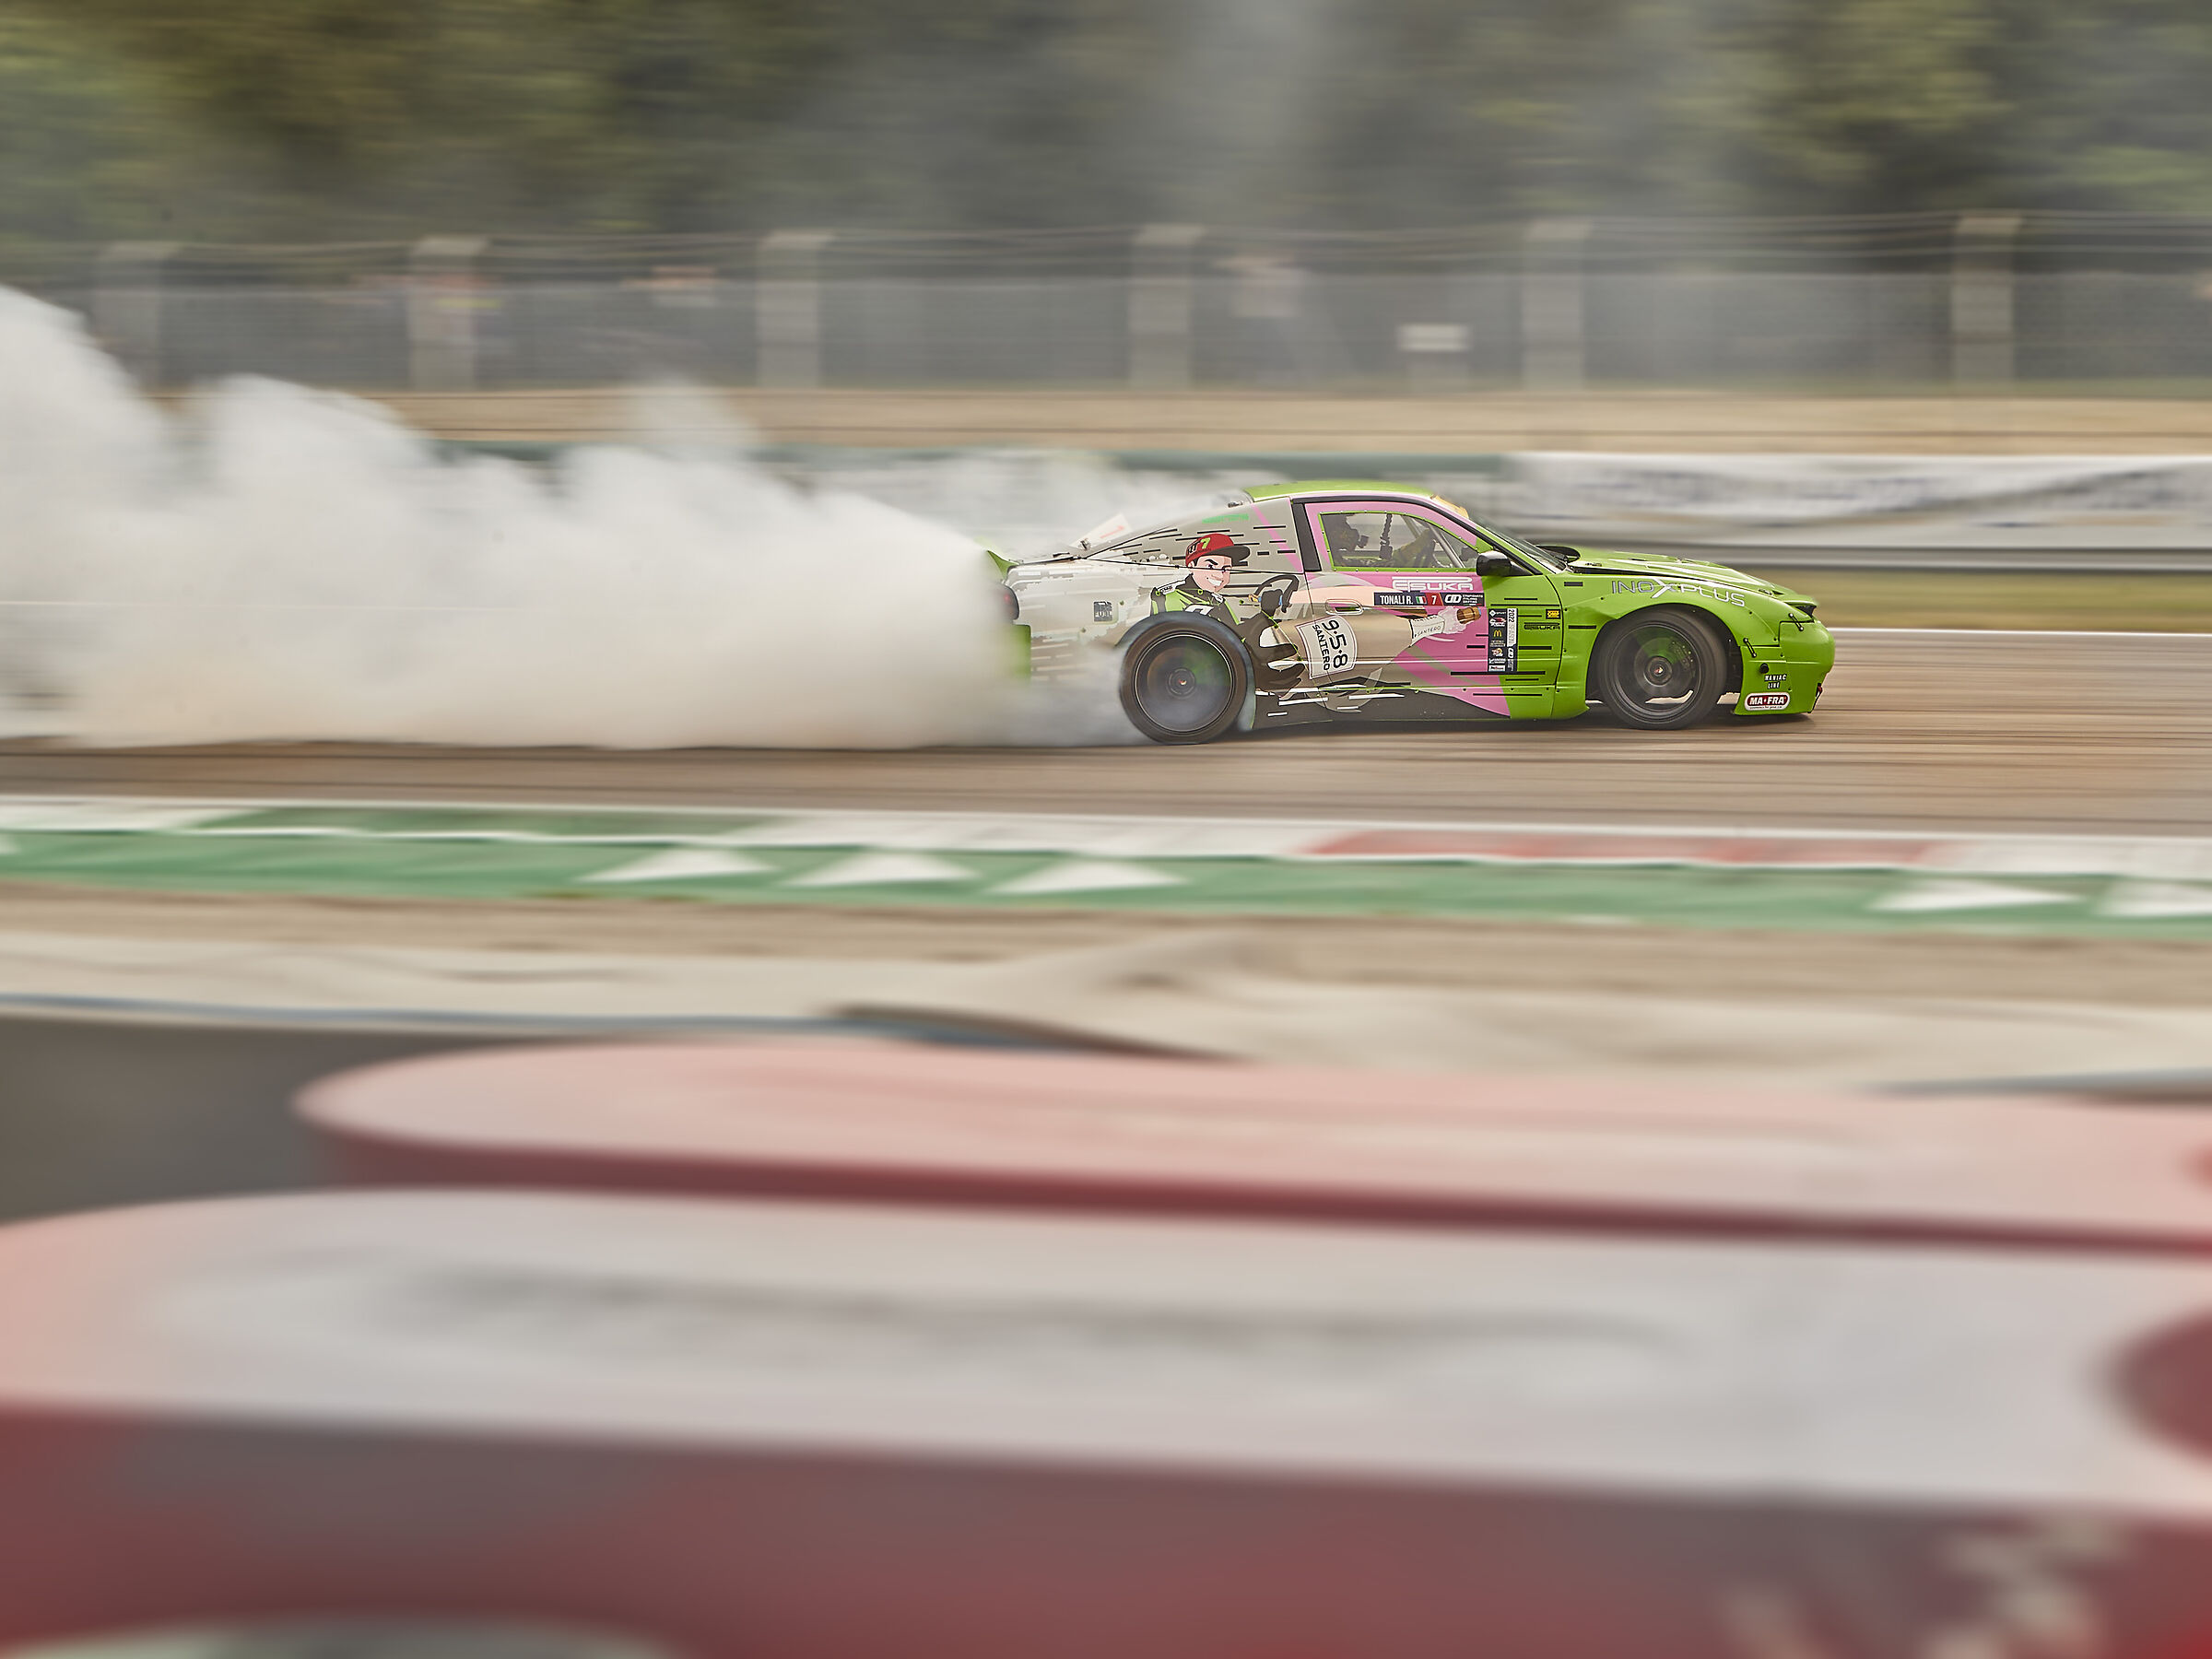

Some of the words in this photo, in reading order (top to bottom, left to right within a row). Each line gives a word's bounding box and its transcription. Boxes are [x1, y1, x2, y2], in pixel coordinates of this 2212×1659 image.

[1379, 594, 1406, 605] TONALI
[1406, 595, 1414, 605] R.
[1430, 595, 1438, 605] 7
[1611, 578, 1746, 607] INOXPLUS
[1312, 624, 1331, 671] SANTERO
